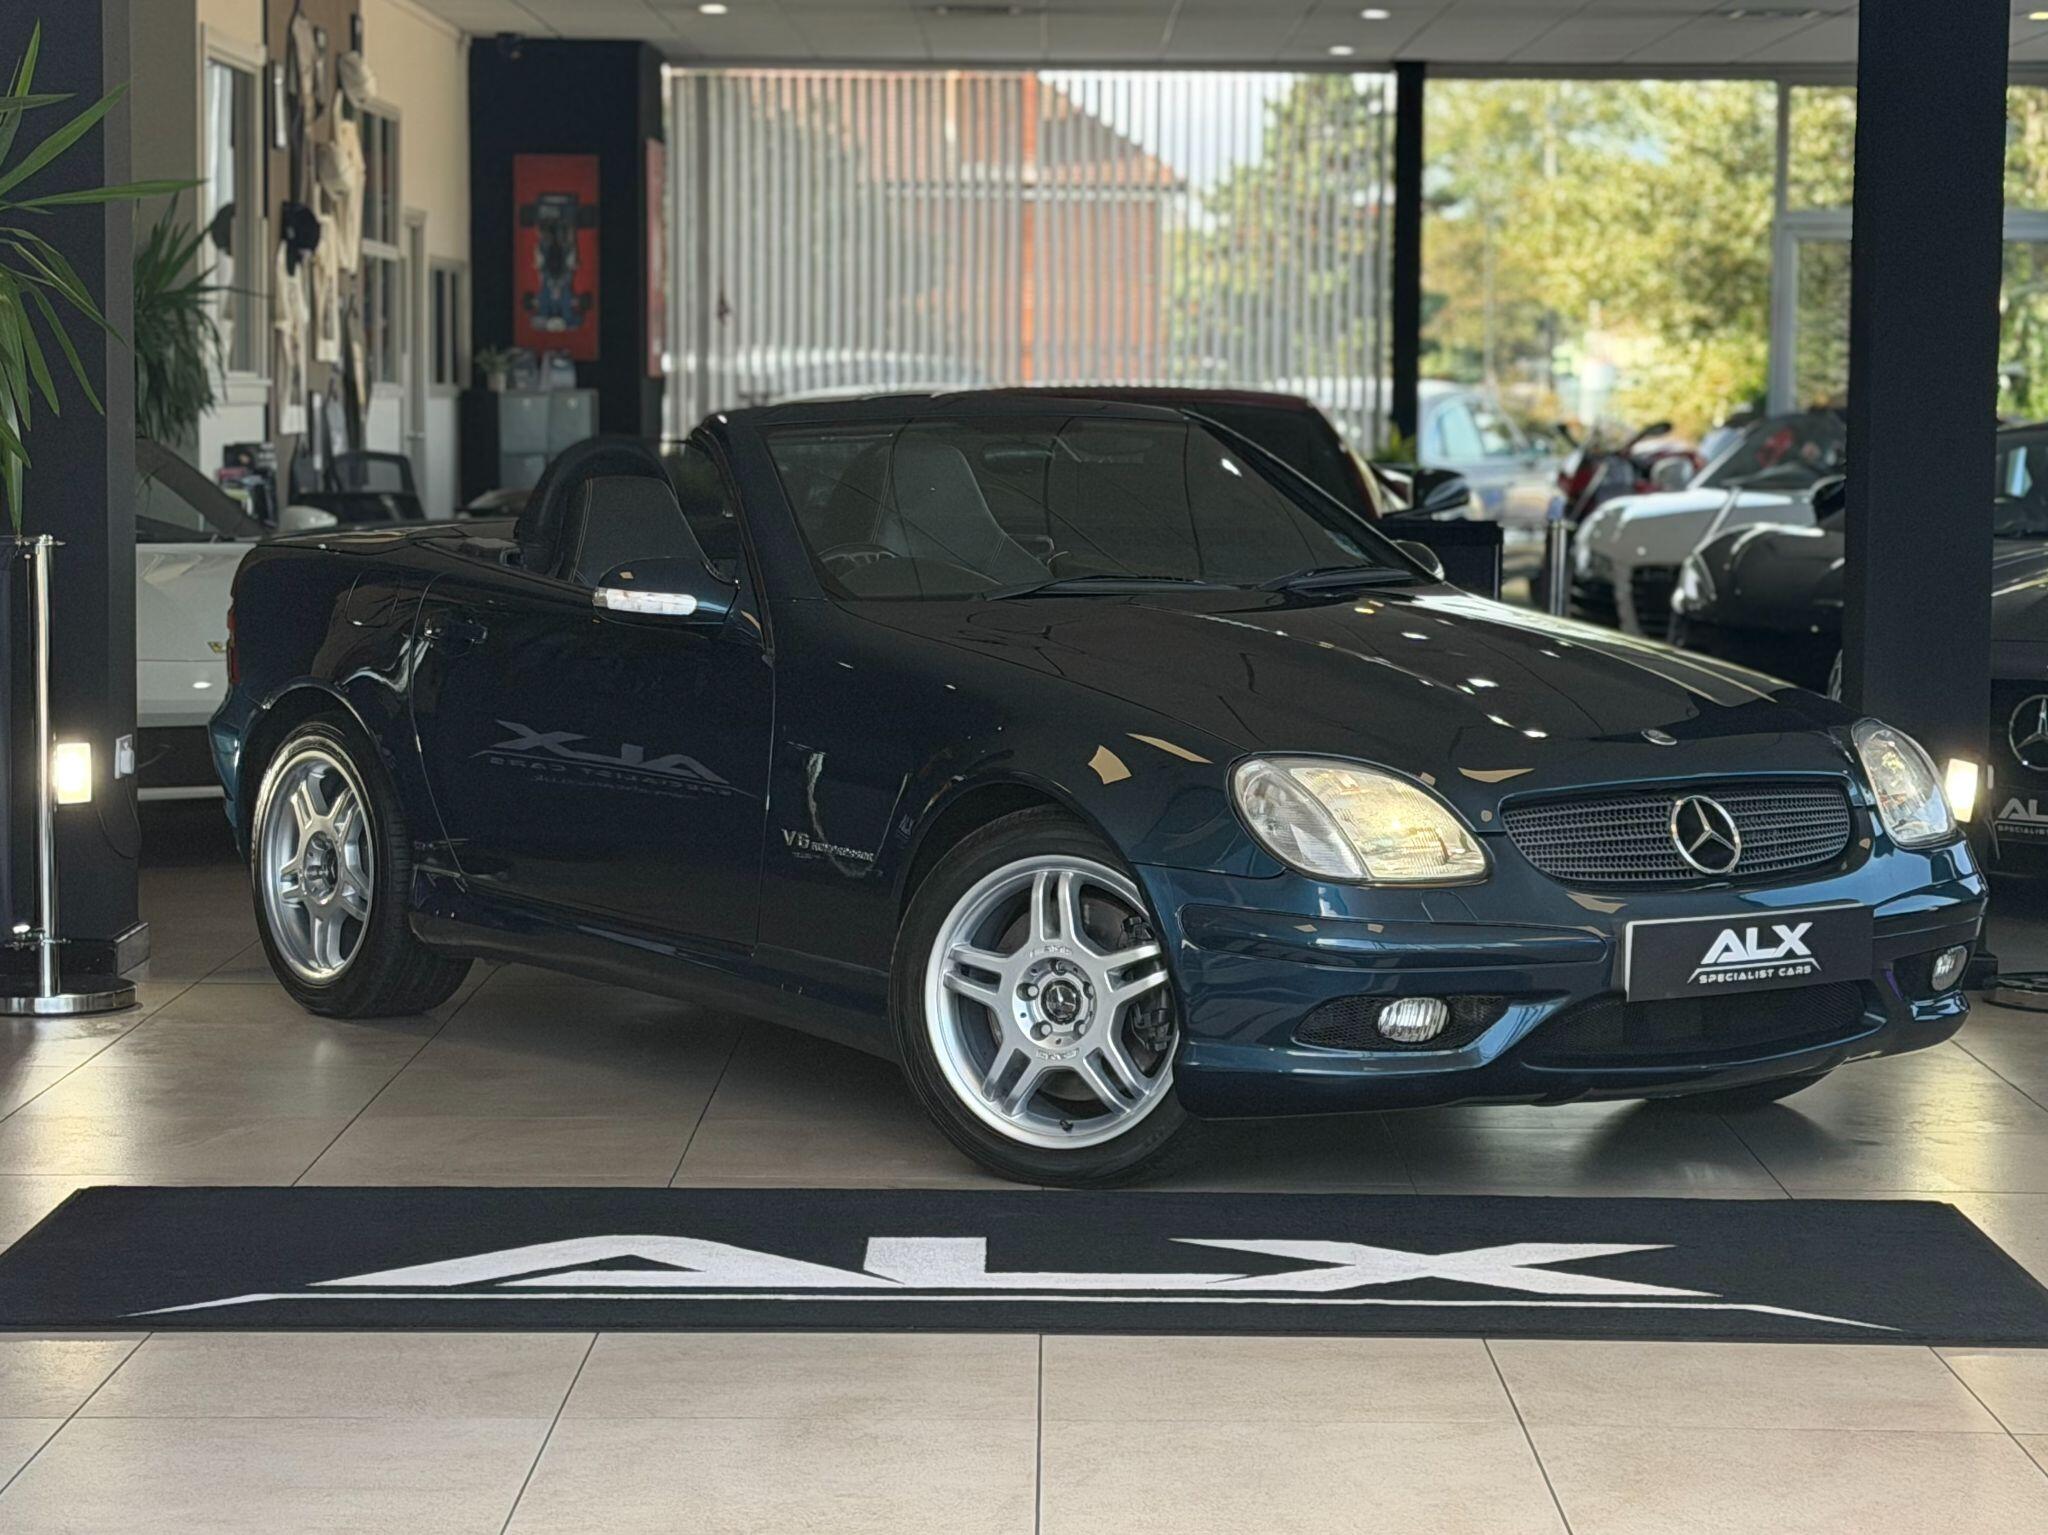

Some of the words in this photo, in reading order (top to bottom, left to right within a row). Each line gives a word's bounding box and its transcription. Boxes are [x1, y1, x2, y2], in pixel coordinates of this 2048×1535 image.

[1998, 797, 2048, 823] AL
[781, 828, 810, 850] V6
[1998, 824, 2048, 836] SPECIALIS
[1700, 922, 1813, 965] ALX
[1699, 968, 1774, 984] SPECIALIST
[1778, 964, 1812, 977] CARS
[305, 1234, 1724, 1297] ALX
